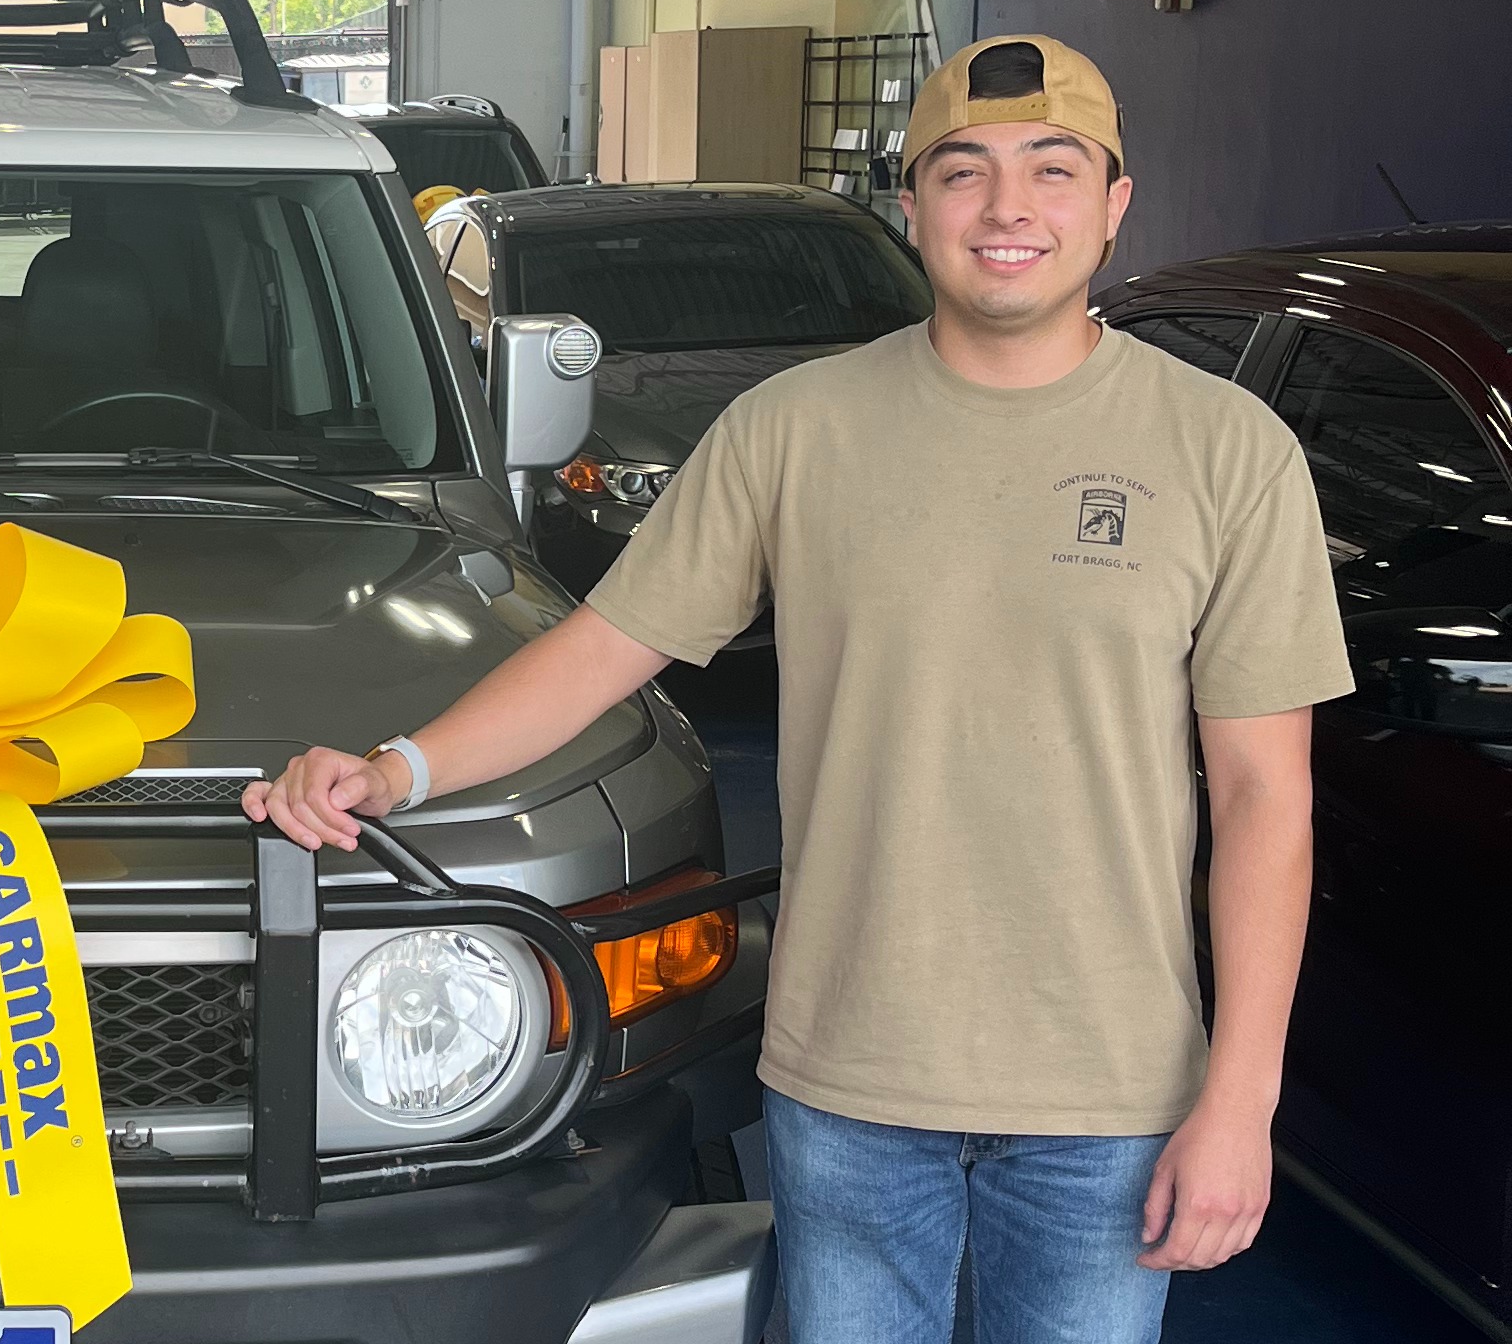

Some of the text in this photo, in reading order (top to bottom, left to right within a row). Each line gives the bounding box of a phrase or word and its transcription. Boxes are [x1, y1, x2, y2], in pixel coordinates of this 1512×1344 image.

[1053, 473, 1157, 501] CONTINUE TO SERVE
[1052, 553, 1143, 572] FORT BRAGG, NC
